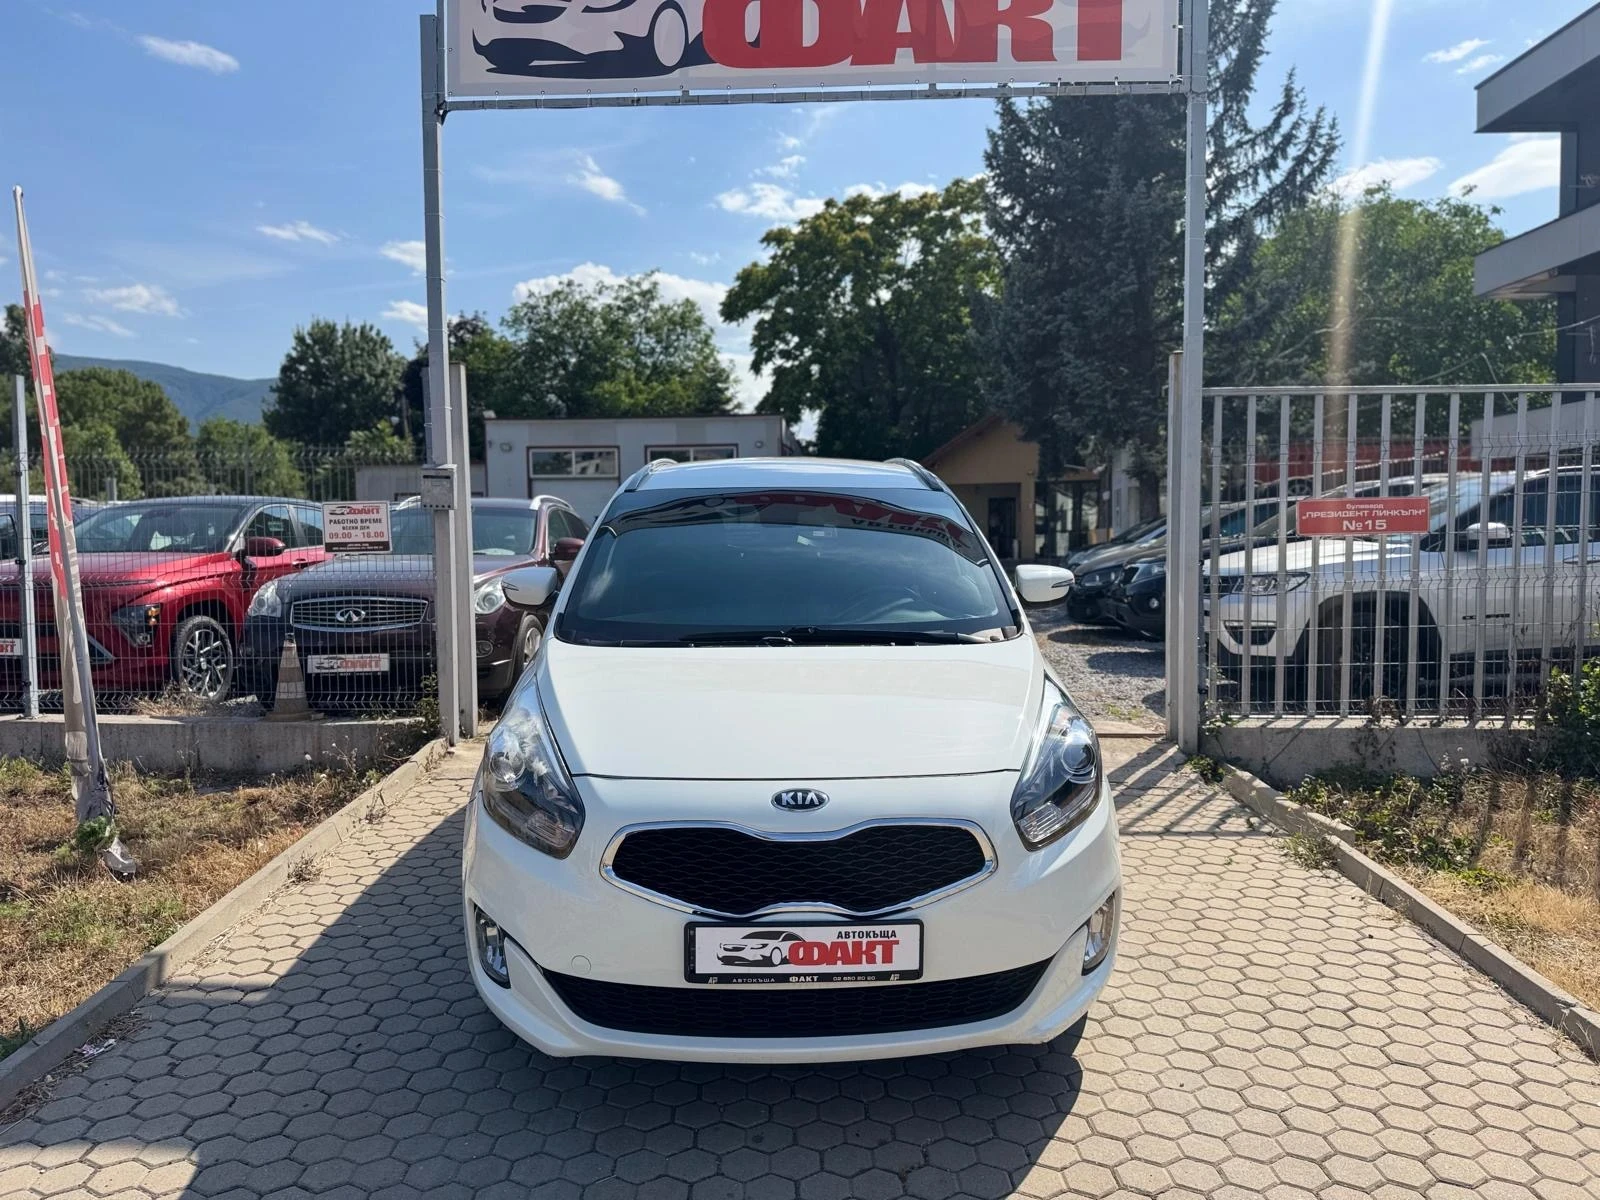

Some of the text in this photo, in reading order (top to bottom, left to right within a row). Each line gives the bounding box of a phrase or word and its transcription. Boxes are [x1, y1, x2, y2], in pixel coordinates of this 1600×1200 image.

[329, 532, 352, 540] 09.00
[781, 791, 820, 805] KIA
[837, 929, 897, 940] АВТОКЪЩА
[788, 940, 900, 967] ФАКТ
[789, 975, 819, 983] ФАКТ
